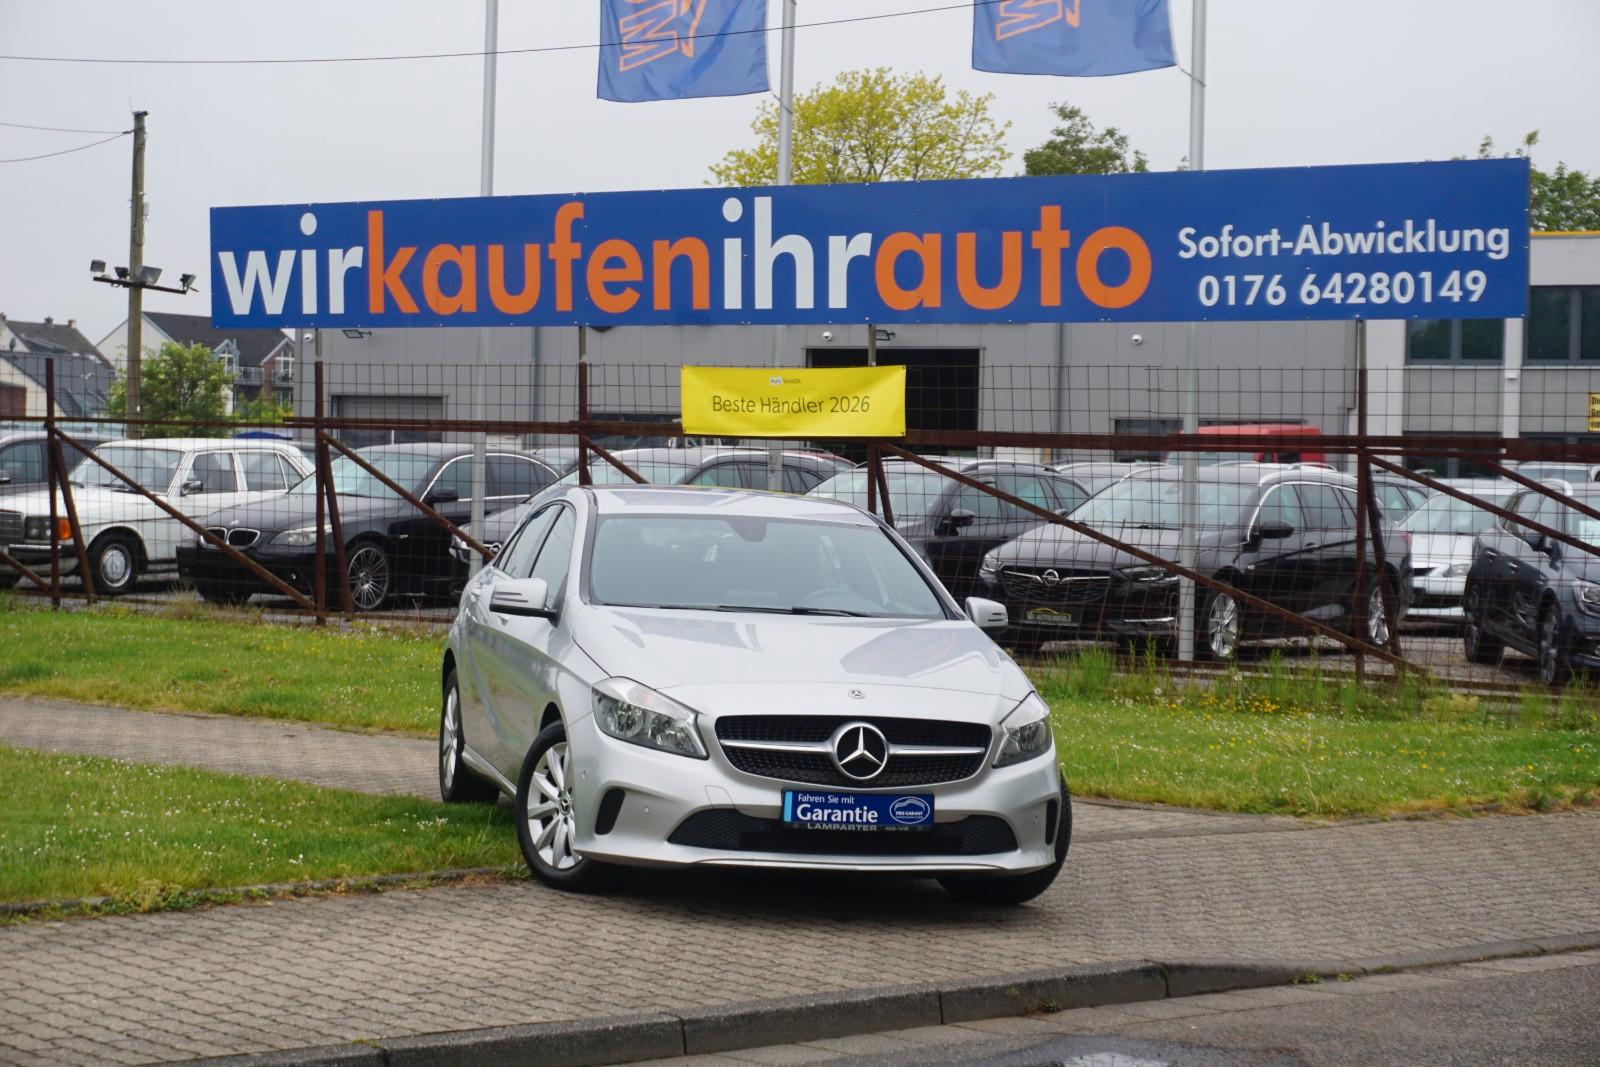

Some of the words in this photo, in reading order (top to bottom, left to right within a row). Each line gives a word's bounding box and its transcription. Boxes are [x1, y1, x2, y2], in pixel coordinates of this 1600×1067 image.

[1178, 219, 1511, 260] Sofort-Abwicklung
[217, 197, 1153, 315] wirkaufenihrauto
[1198, 274, 1287, 307] 0176
[1300, 270, 1488, 306] 64280149
[712, 395, 756, 413] Beste
[760, 395, 826, 415] Händler
[830, 395, 871, 413] 2026
[798, 793, 825, 804] Fahren
[827, 794, 839, 804] Sie
[841, 795, 855, 805] mit
[796, 803, 878, 824] Garantie
[807, 822, 877, 832] LAMPARTER
